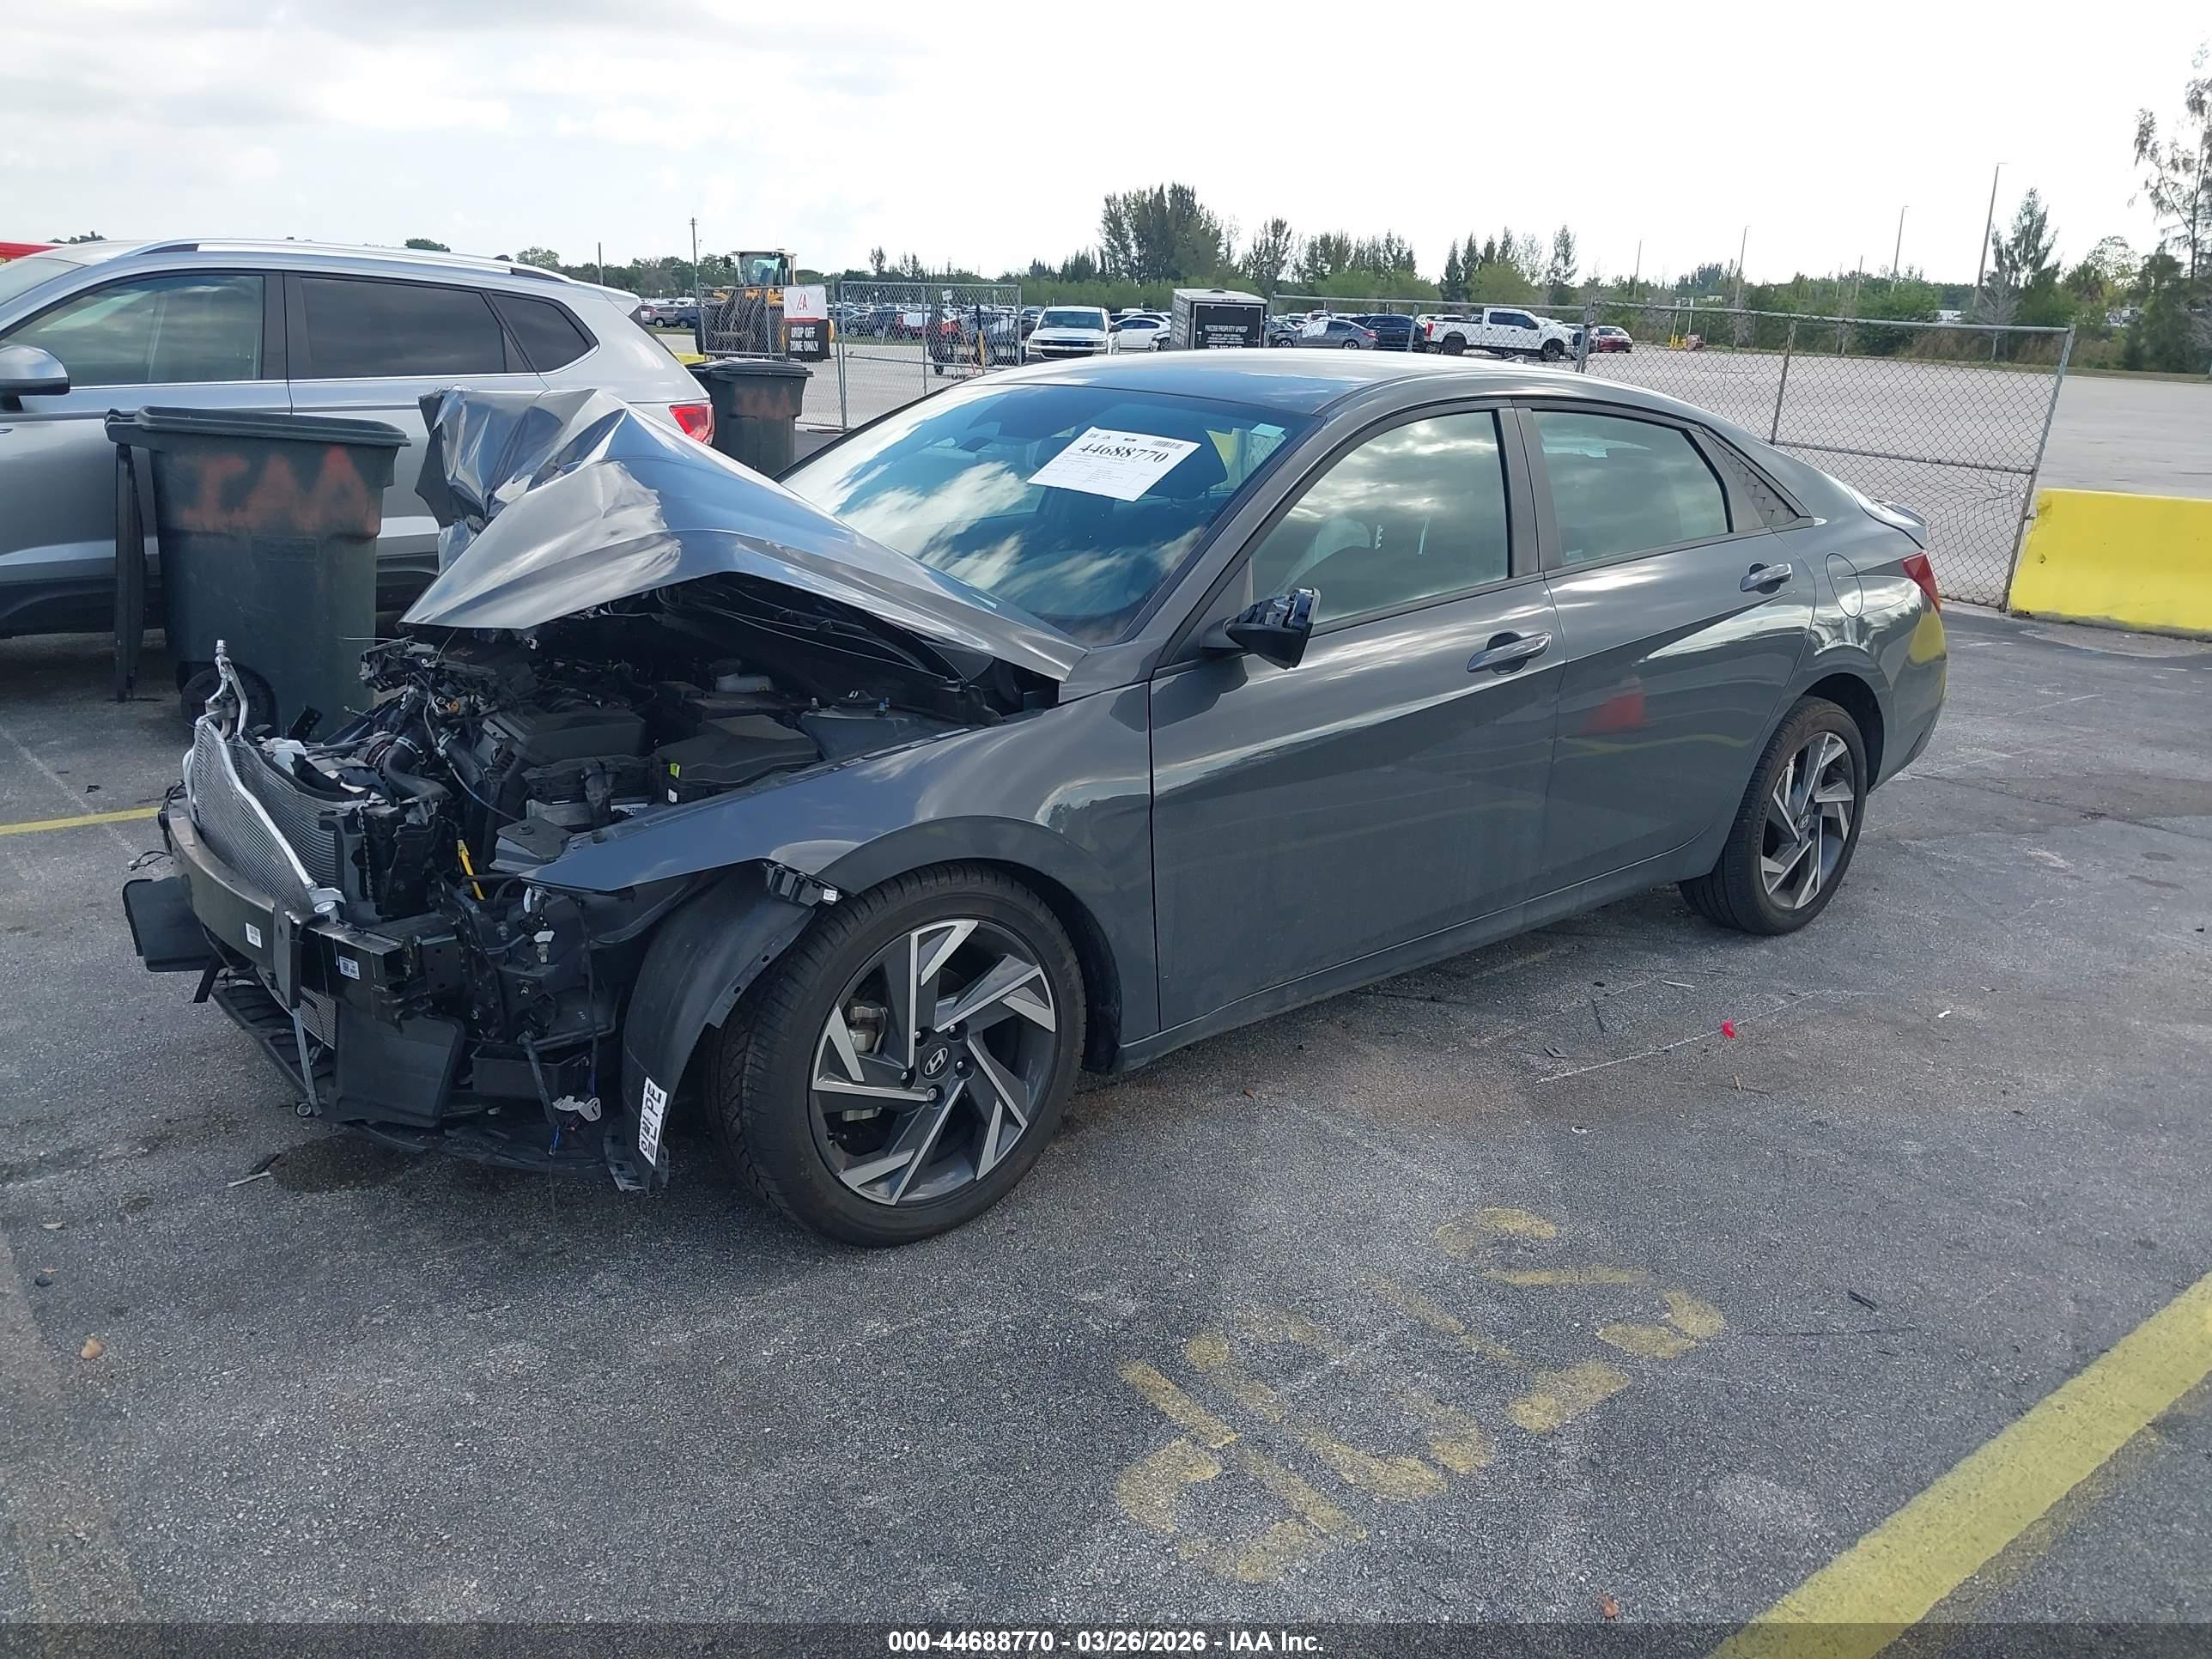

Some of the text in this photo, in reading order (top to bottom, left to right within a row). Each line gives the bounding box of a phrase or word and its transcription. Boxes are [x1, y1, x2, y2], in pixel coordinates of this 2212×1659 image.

[790, 340, 819, 352] ZONE ONLY
[791, 327, 816, 338] DROP OFF
[1079, 442, 1170, 465] 44688770
[178, 444, 380, 536] IAA
[643, 1082, 662, 1117] PE
[1115, 1206, 1725, 1583] STOP
